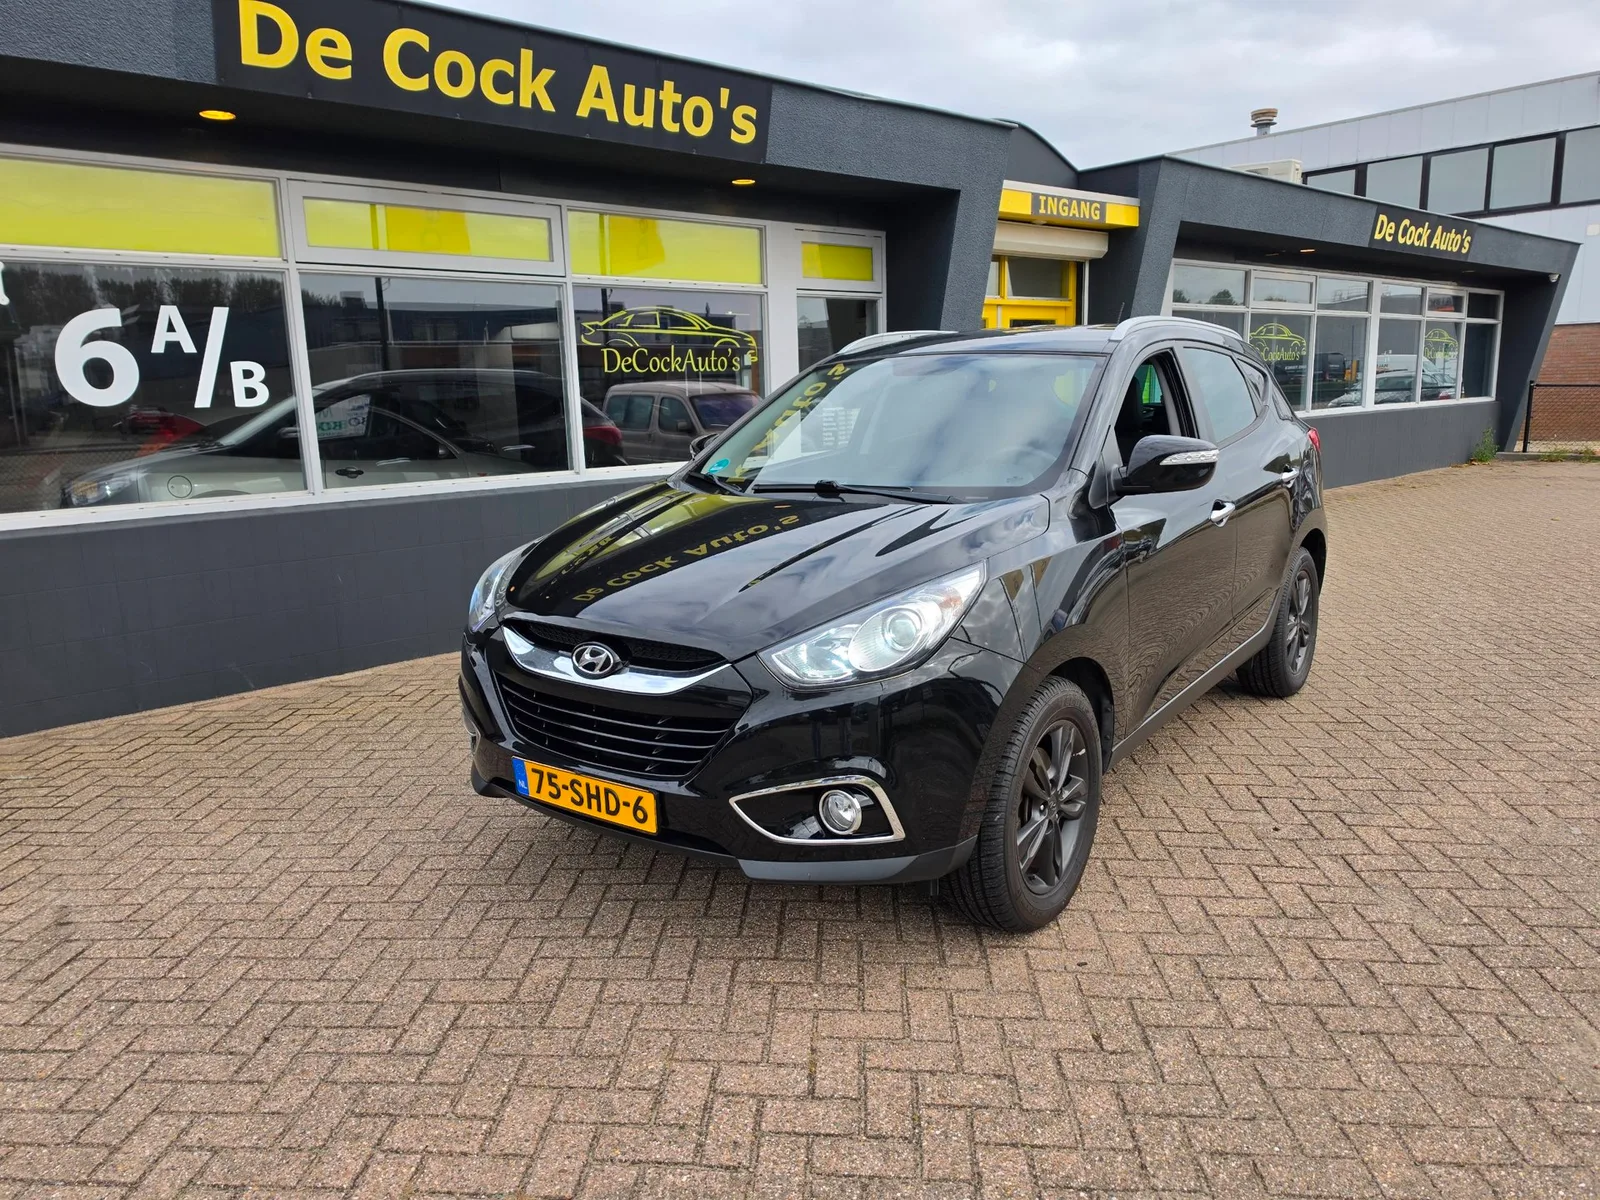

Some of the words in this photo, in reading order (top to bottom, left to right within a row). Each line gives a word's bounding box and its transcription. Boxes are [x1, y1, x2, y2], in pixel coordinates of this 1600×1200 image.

[238, 0, 353, 81] De
[382, 27, 556, 113] Cock
[575, 64, 758, 145] Auto's
[1038, 195, 1101, 220] INGANG
[1374, 214, 1396, 242] De
[1397, 218, 1431, 247] Cock
[1430, 225, 1472, 254] Auto's
[54, 307, 140, 407] 6
[601, 344, 741, 373] DeCockAuto's
[1261, 345, 1300, 362] CockAuto's
[518, 779, 528, 790] NL
[531, 767, 649, 825] 75-SHD-6
